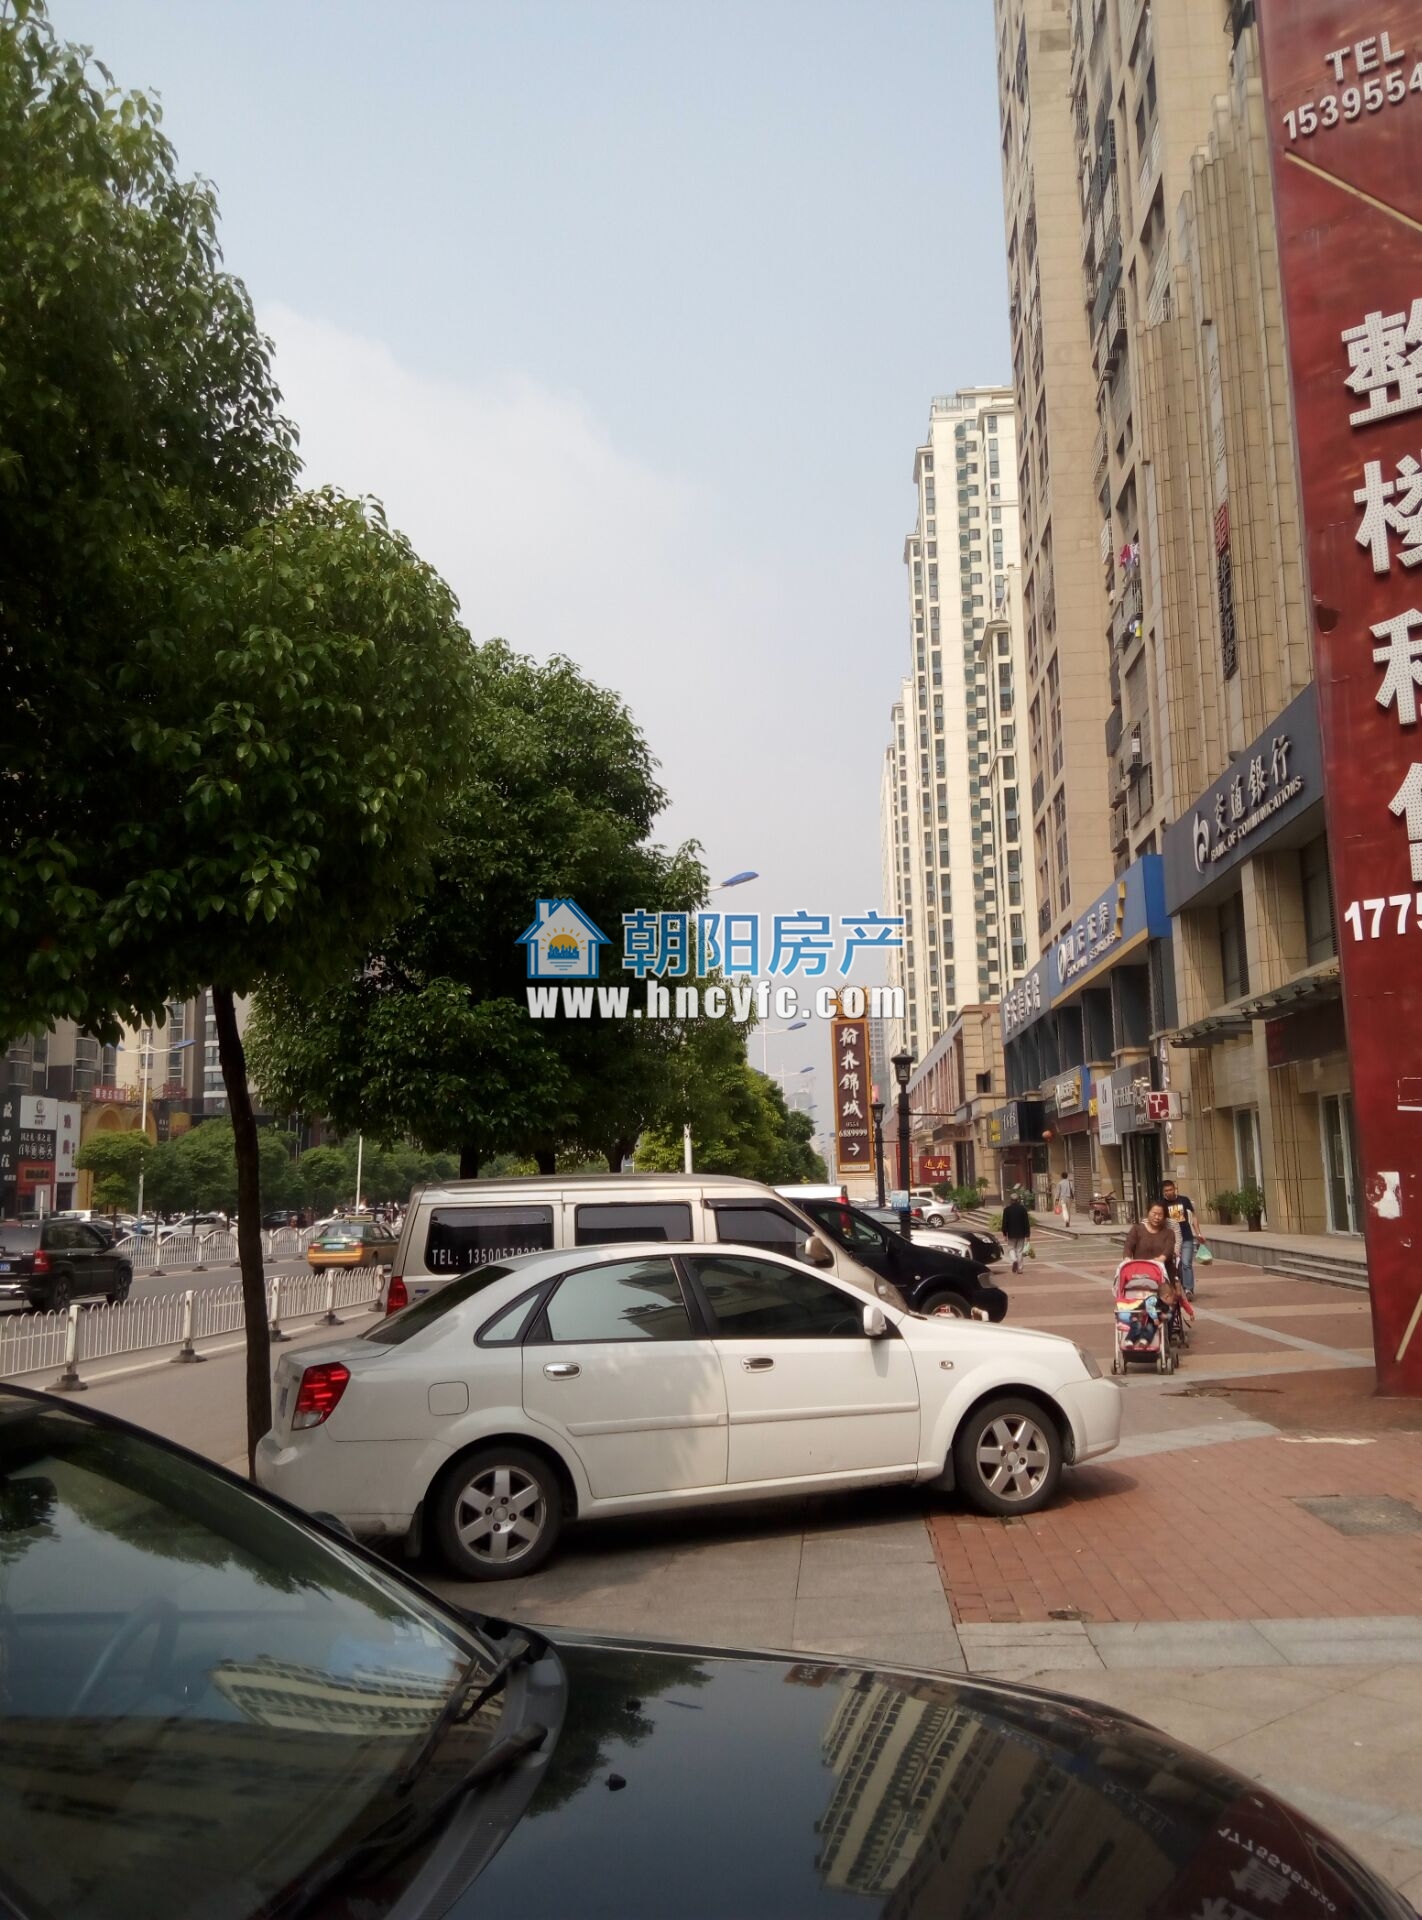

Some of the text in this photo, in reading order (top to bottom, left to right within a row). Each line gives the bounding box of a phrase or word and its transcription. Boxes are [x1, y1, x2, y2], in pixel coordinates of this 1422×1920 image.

[1325, 31, 1405, 83] TEL
[1282, 62, 1422, 142] 1539554
[1341, 298, 1422, 882] 整楼
[1210, 775, 1303, 862] BANK OF COMMUNICATIONS
[1344, 893, 1422, 942] 177
